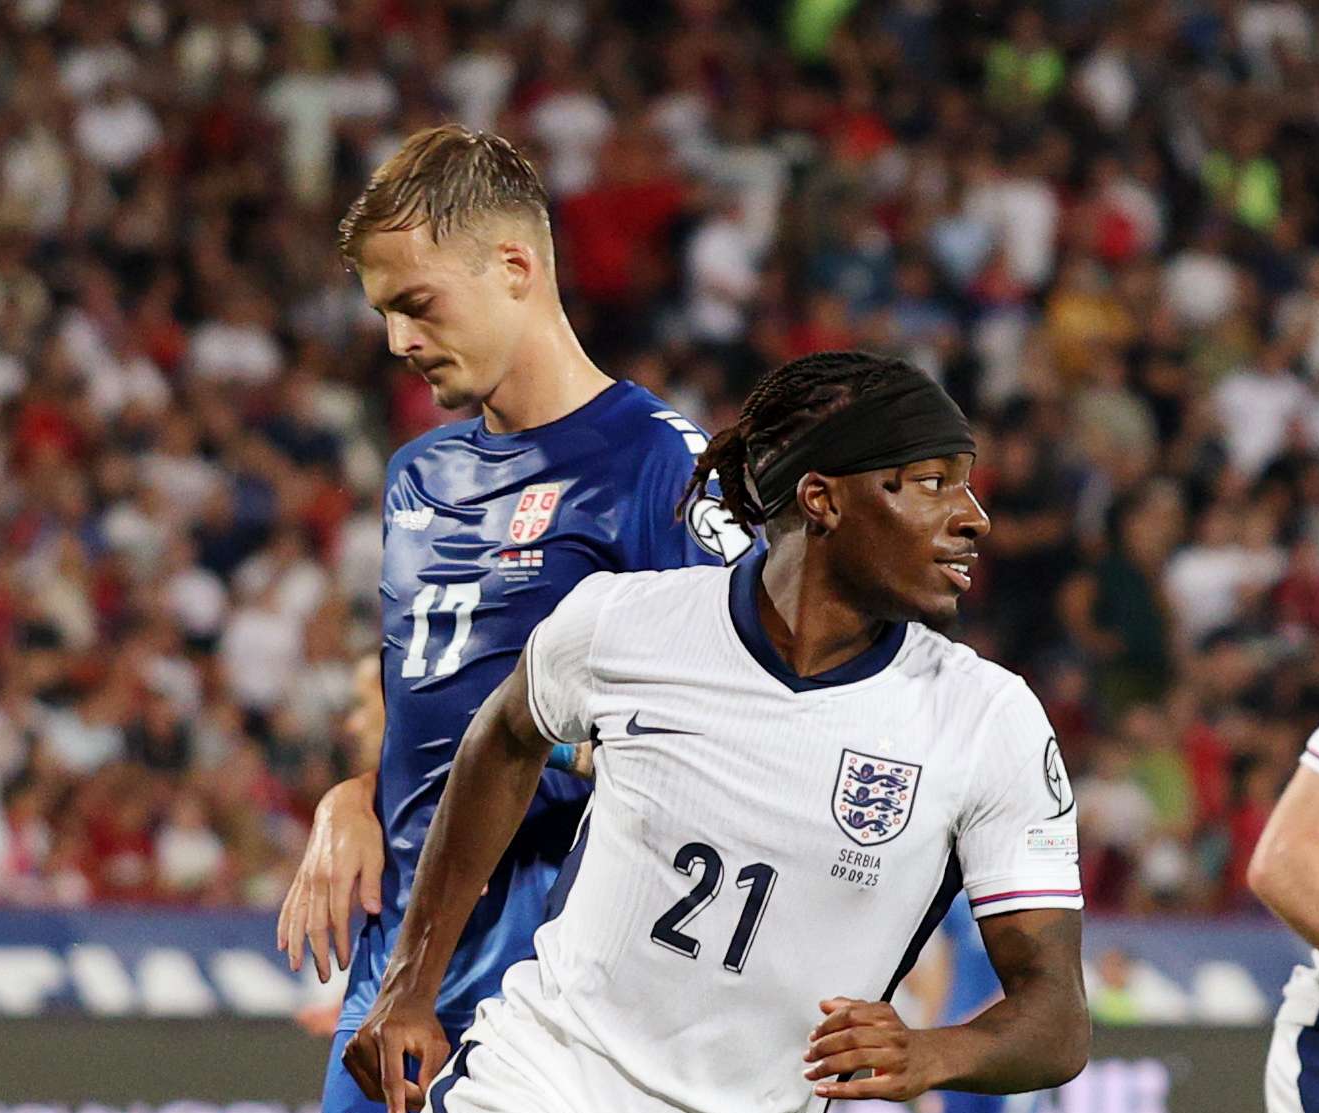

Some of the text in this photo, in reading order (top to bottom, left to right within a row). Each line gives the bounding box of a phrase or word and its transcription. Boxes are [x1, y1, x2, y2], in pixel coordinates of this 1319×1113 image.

[401, 582, 481, 678] 17
[830, 863, 880, 887] 09.09.25
[838, 848, 881, 870] SERBIA
[650, 842, 778, 974] 21
